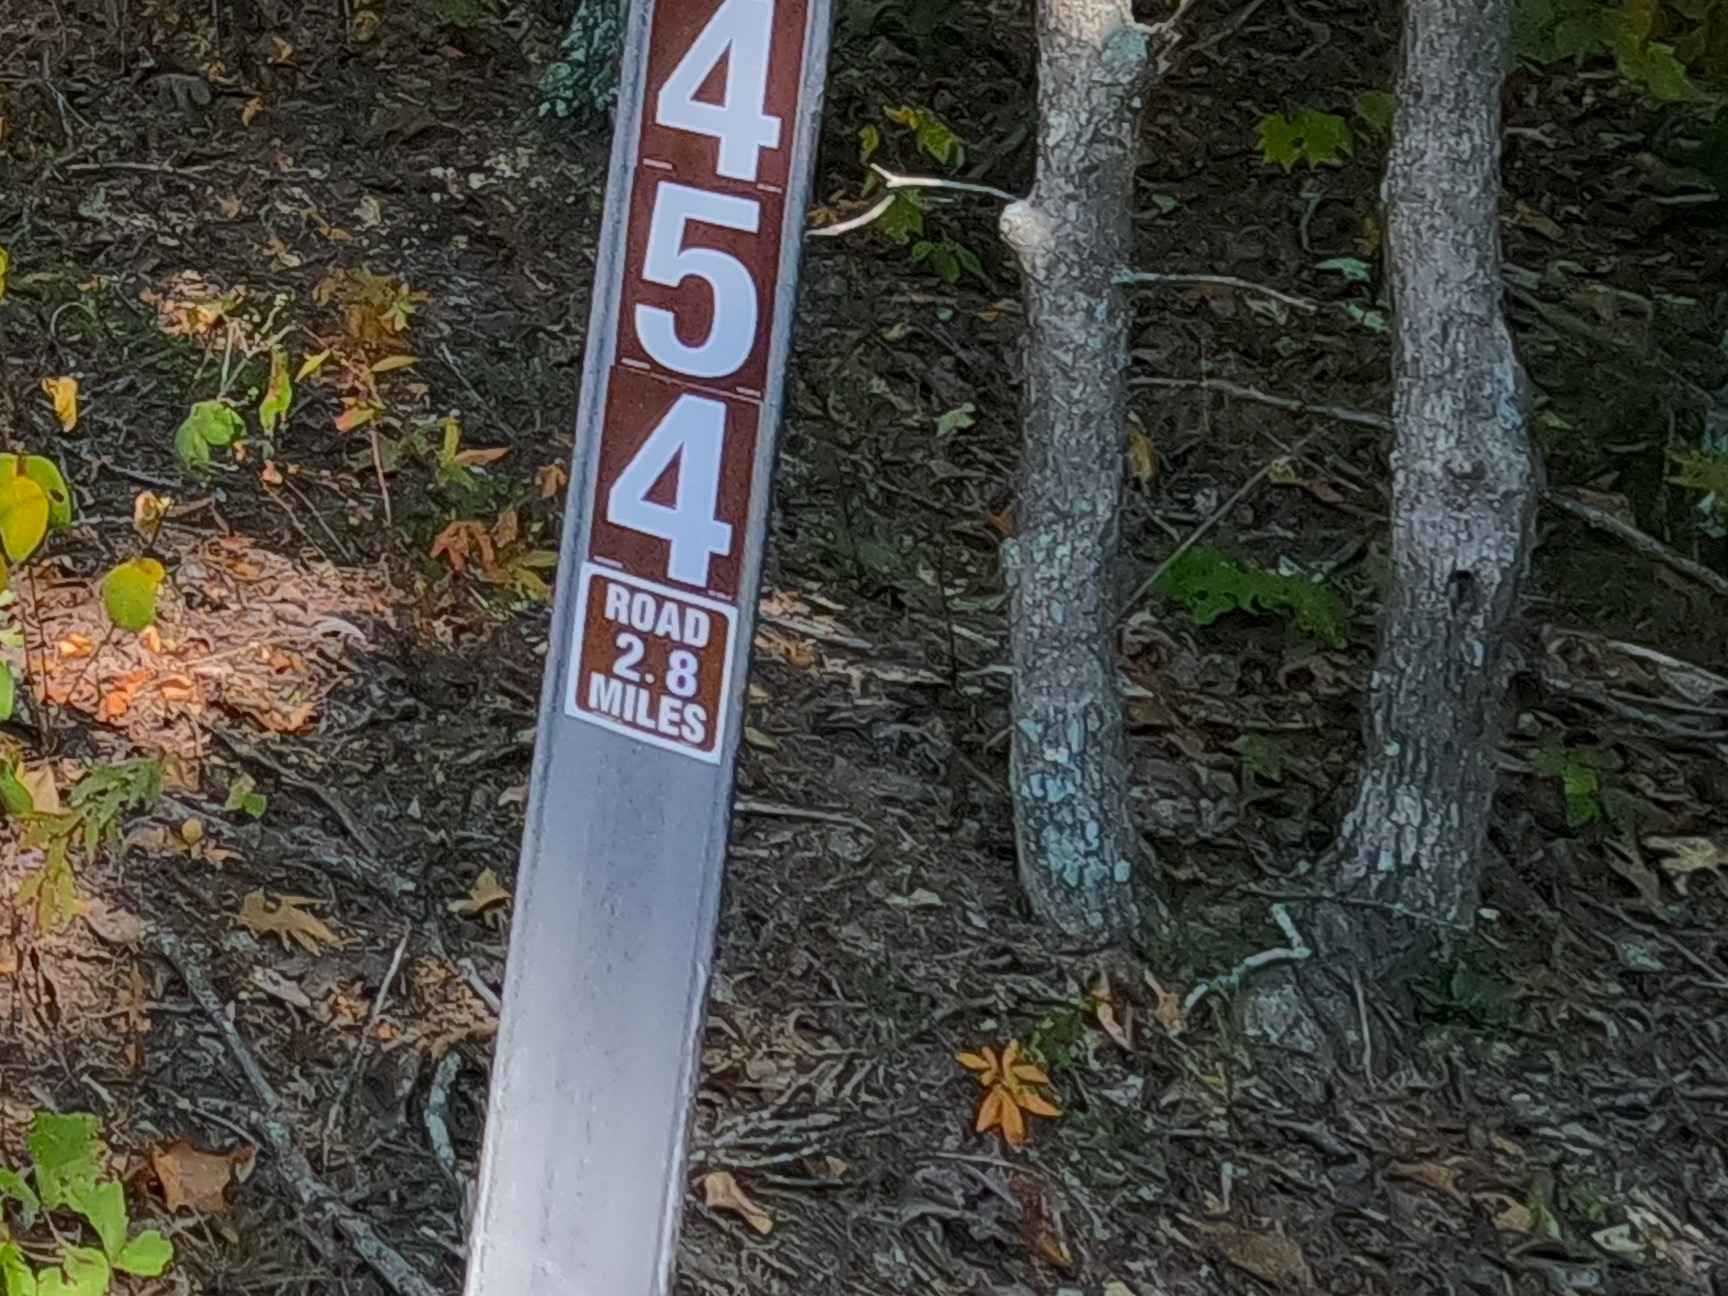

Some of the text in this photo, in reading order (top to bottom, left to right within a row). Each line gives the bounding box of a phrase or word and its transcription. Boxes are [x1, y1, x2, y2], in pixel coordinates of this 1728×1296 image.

[604, 582, 711, 648] ROAD
[612, 632, 699, 698] 2.8
[588, 670, 708, 744] MILES
